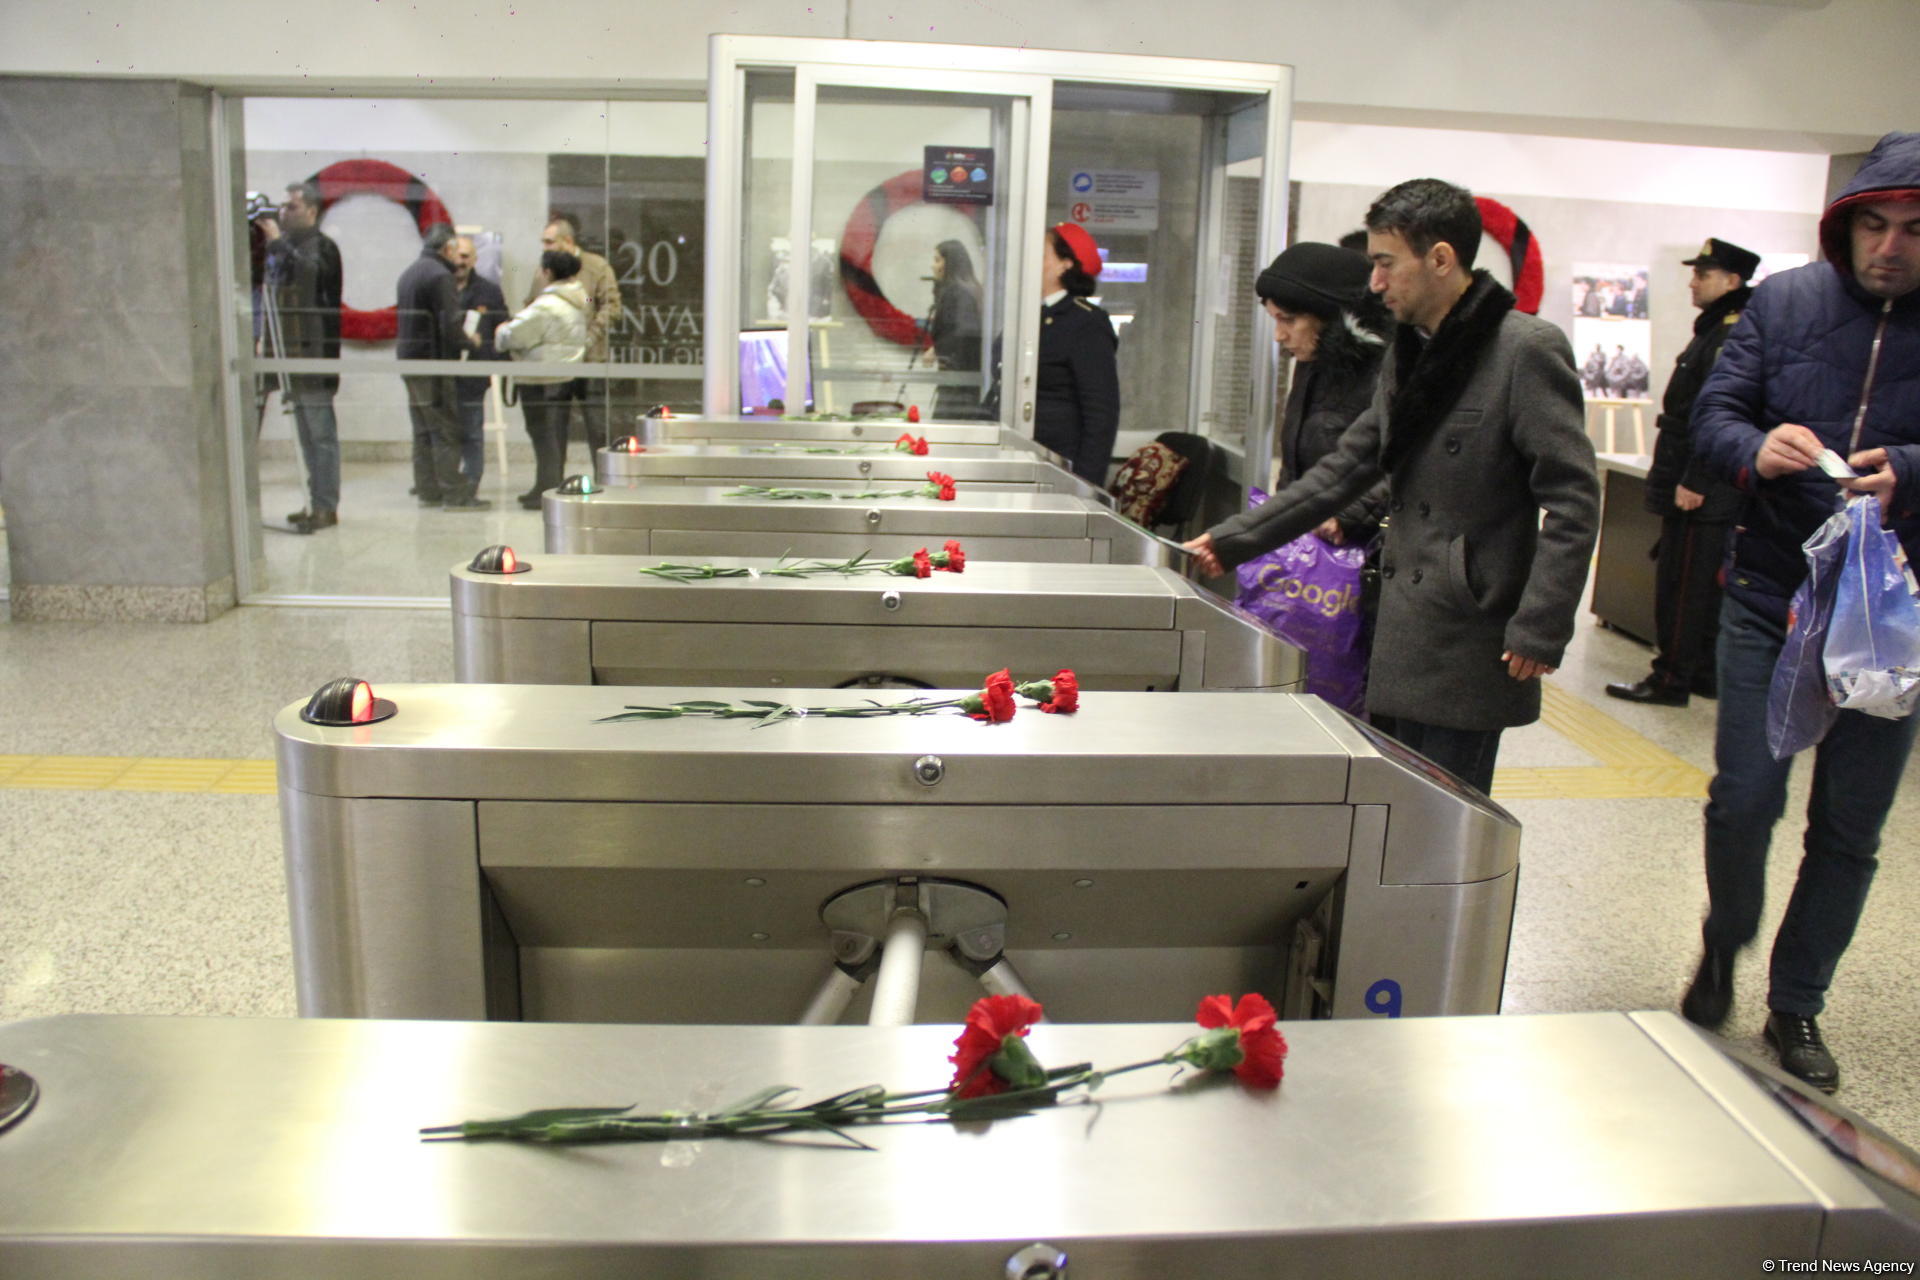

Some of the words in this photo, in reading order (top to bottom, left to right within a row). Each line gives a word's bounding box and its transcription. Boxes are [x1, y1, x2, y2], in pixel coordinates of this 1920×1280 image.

[616, 240, 678, 287] 20
[608, 304, 702, 335] NVA
[1364, 978, 1403, 1018] 9
